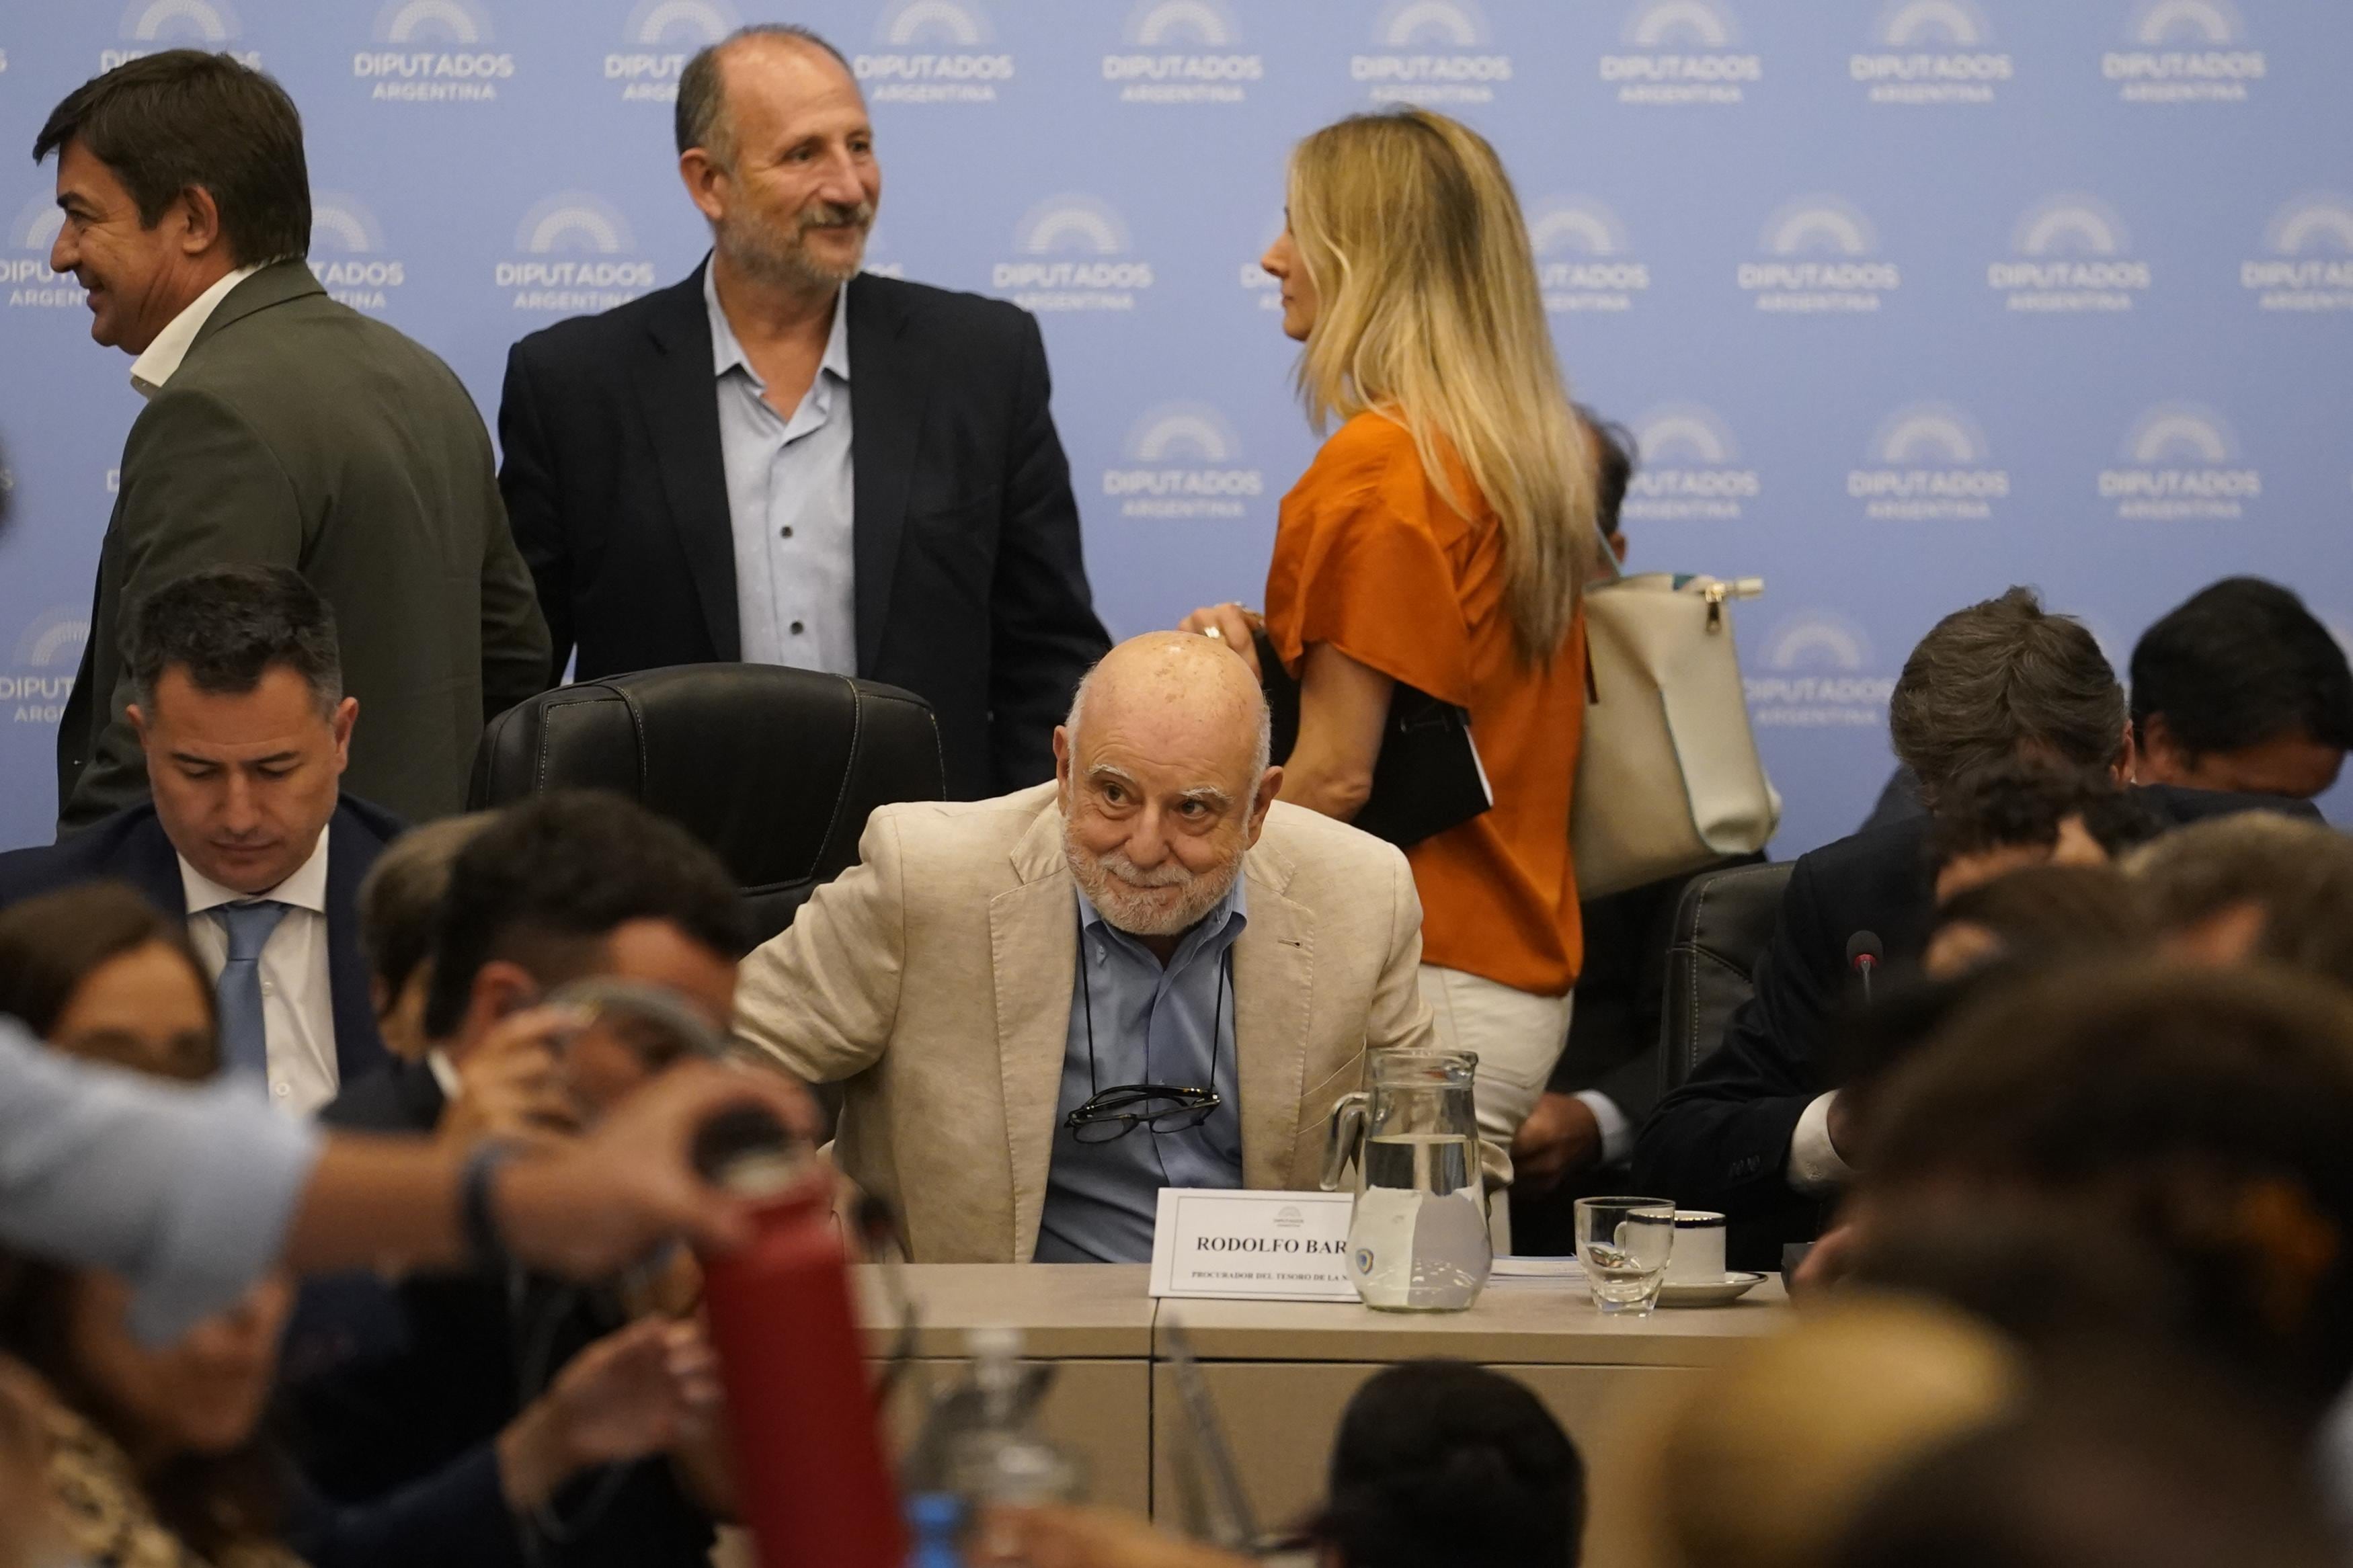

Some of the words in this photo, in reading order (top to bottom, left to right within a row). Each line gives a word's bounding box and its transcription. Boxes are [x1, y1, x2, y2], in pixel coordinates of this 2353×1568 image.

[354, 53, 514, 78] DIPUTADOS
[852, 54, 1014, 79] DIPUTADOS
[1103, 54, 1263, 80] DIPUTADOS
[372, 82, 496, 101] ARGENTINA
[495, 263, 655, 287] DIPUTADOS
[993, 263, 1154, 288] DIPUTADOS
[1103, 470, 1263, 495] DIPUTADOS
[1197, 1237, 1299, 1253] RODOLFO
[1192, 1272, 1253, 1280] PROCURADOR
[1255, 1272, 1273, 1280] DEL
